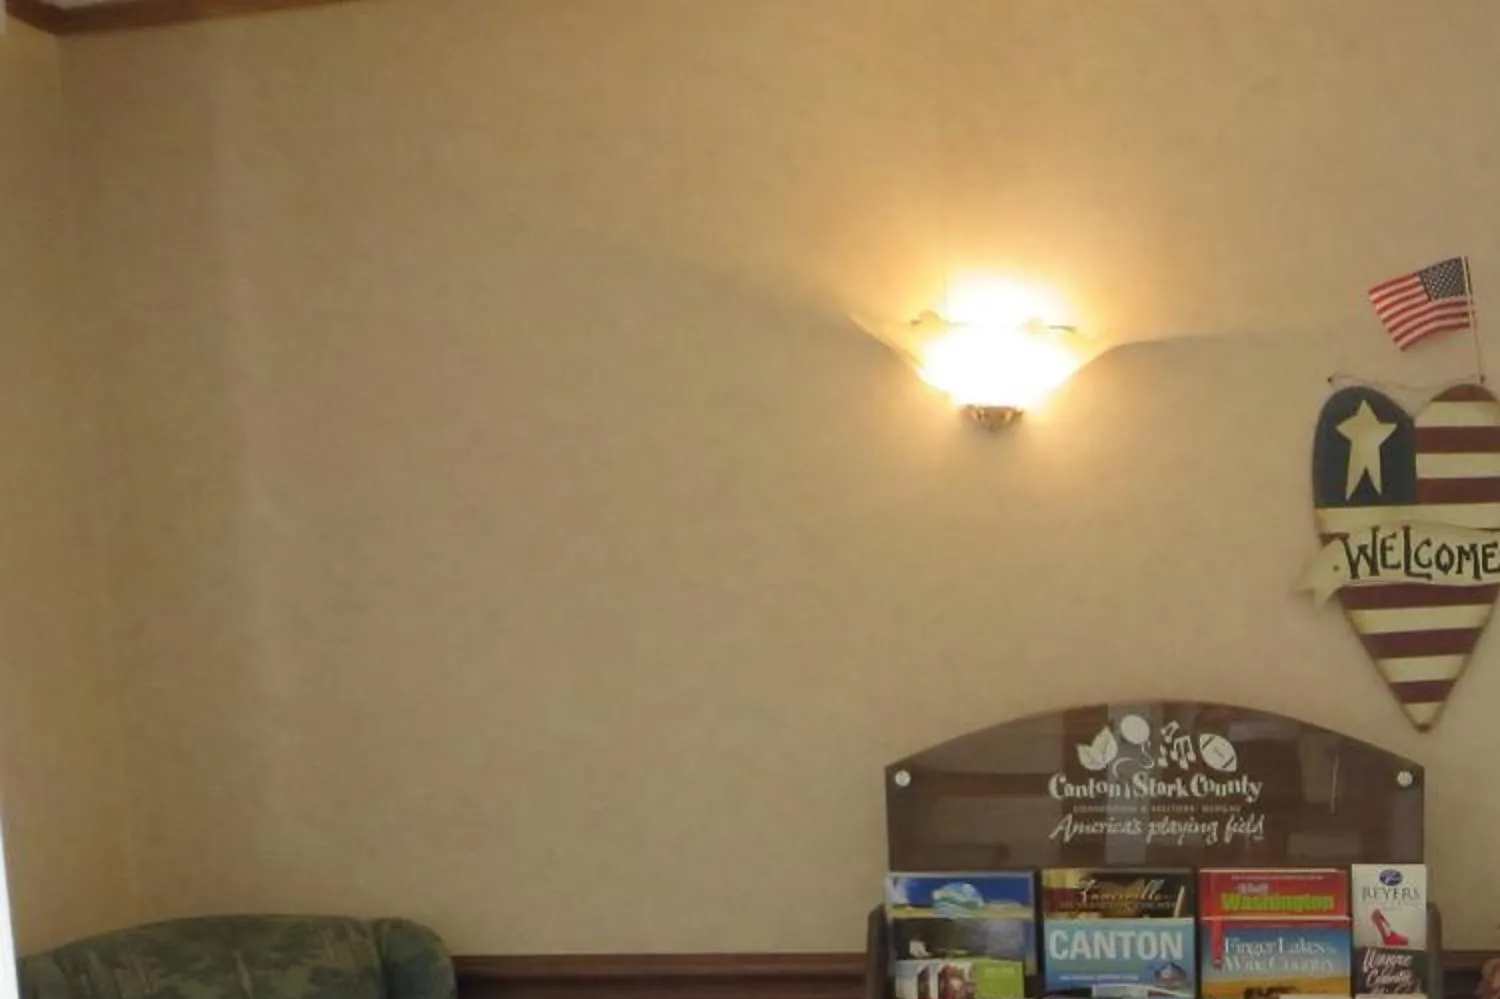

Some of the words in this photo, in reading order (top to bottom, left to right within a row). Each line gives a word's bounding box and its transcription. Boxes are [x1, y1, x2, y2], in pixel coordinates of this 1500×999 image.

[1190, 773, 1263, 803] County
[1049, 813, 1142, 842] America's
[1147, 817, 1219, 845] playing
[1224, 814, 1265, 844] field
[1050, 929, 1183, 961] CANTON
